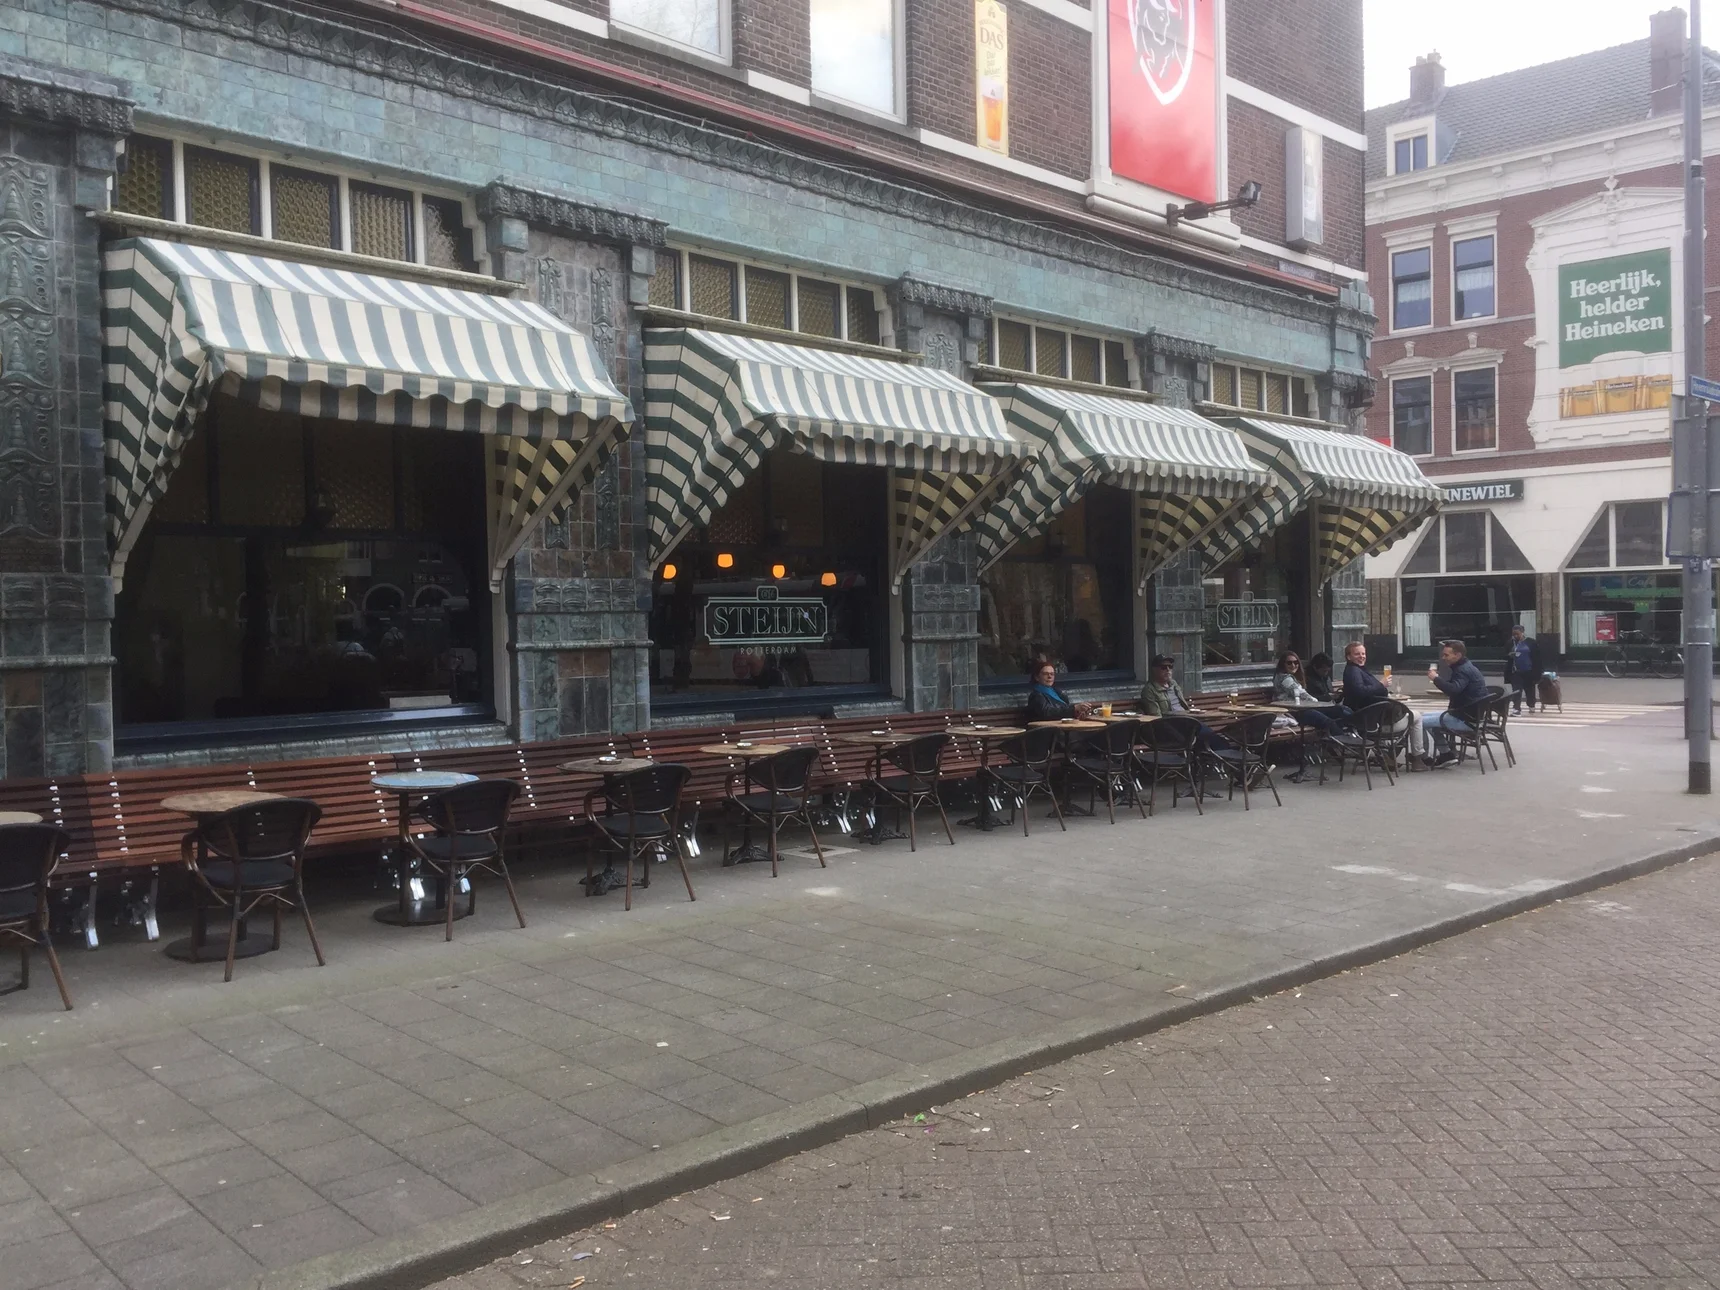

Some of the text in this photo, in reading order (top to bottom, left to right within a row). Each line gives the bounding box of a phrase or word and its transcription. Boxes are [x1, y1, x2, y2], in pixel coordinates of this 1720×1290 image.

[980, 26, 1004, 51] DAS
[1570, 269, 1662, 298] Heerlijk,
[1580, 294, 1650, 318] helder
[1565, 315, 1665, 341] Heineken
[713, 606, 820, 636] STEIJN
[1221, 605, 1276, 627] STEIJN
[740, 645, 797, 656] ROTTERDAM
